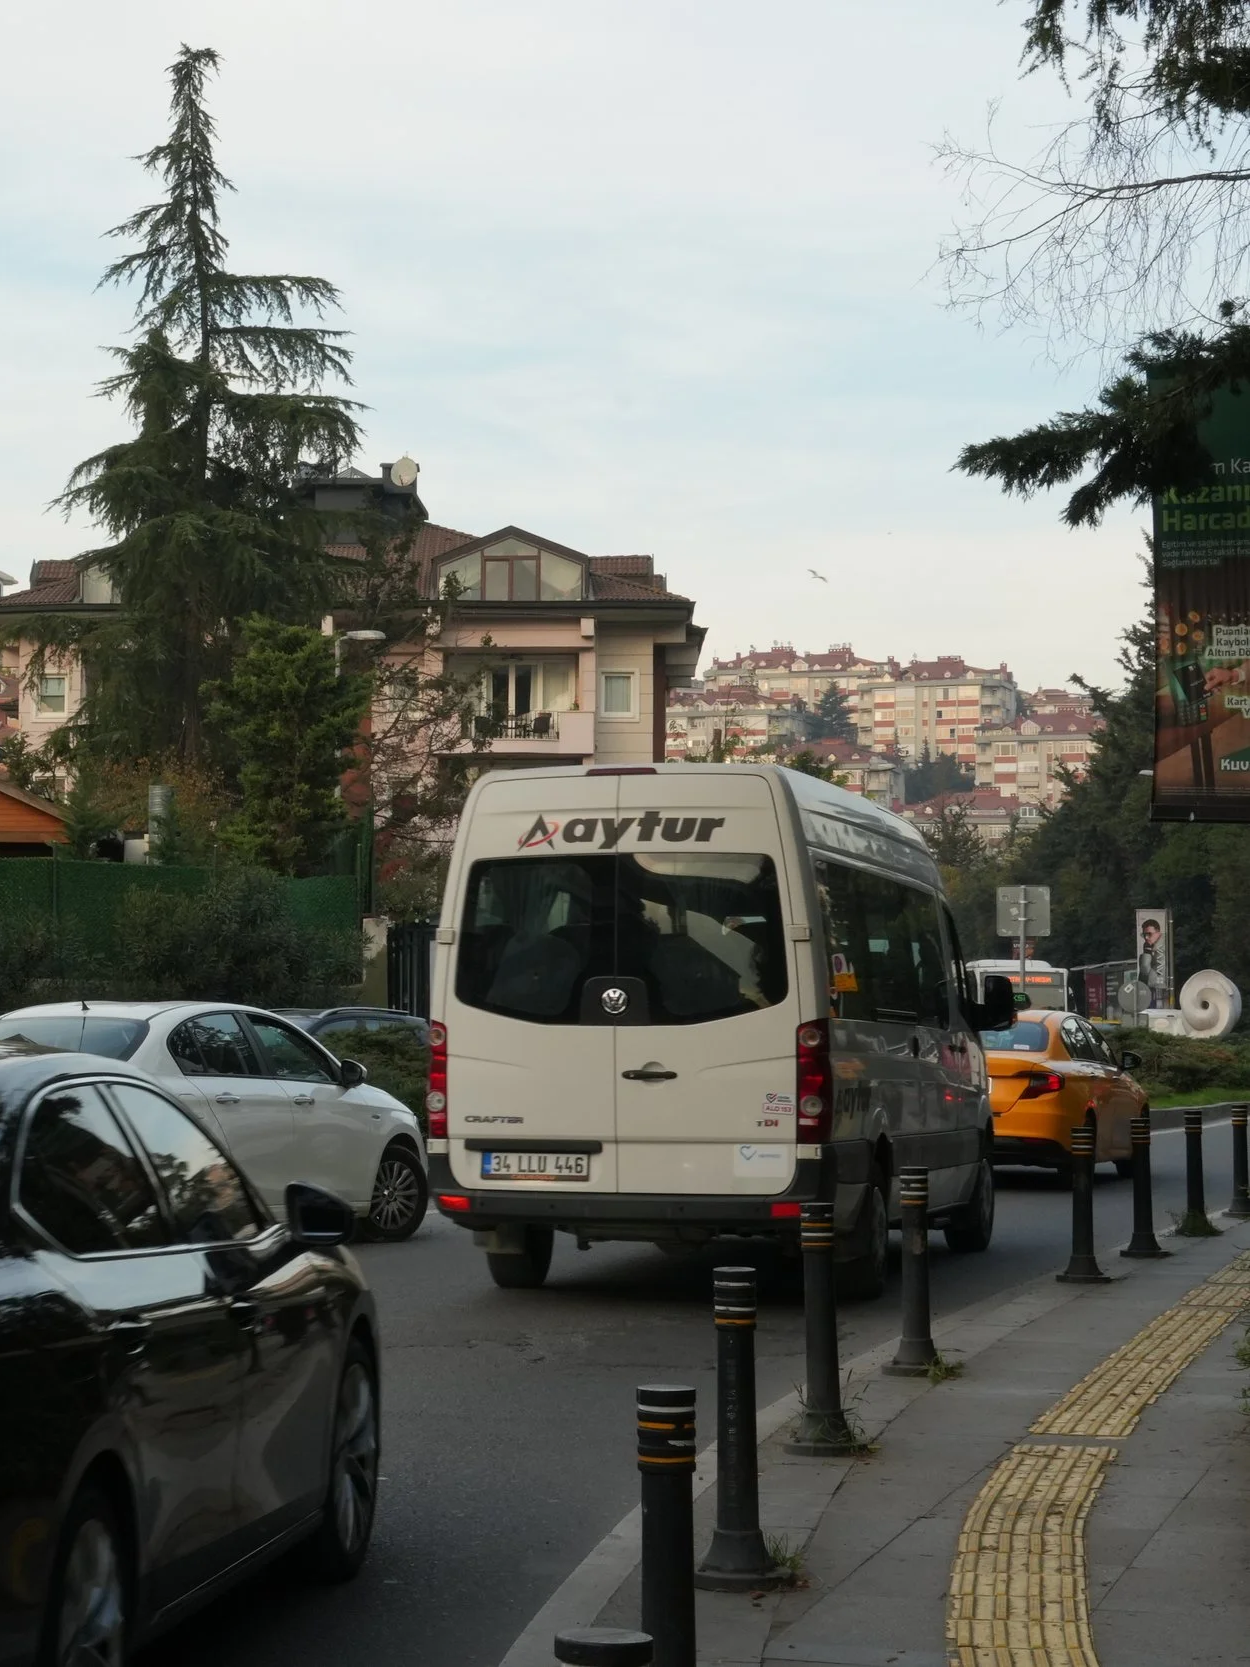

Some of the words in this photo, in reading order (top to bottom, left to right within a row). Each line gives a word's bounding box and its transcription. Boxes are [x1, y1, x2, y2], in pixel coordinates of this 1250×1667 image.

[1215, 627, 1250, 636] Puanla
[1227, 697, 1248, 706] Kart
[562, 810, 726, 850] aytur
[464, 1115, 524, 1124] CRAFTER
[755, 1119, 779, 1127] TDI
[493, 1155, 511, 1173] 34
[518, 1155, 548, 1173] LLU
[554, 1156, 584, 1174] 446
